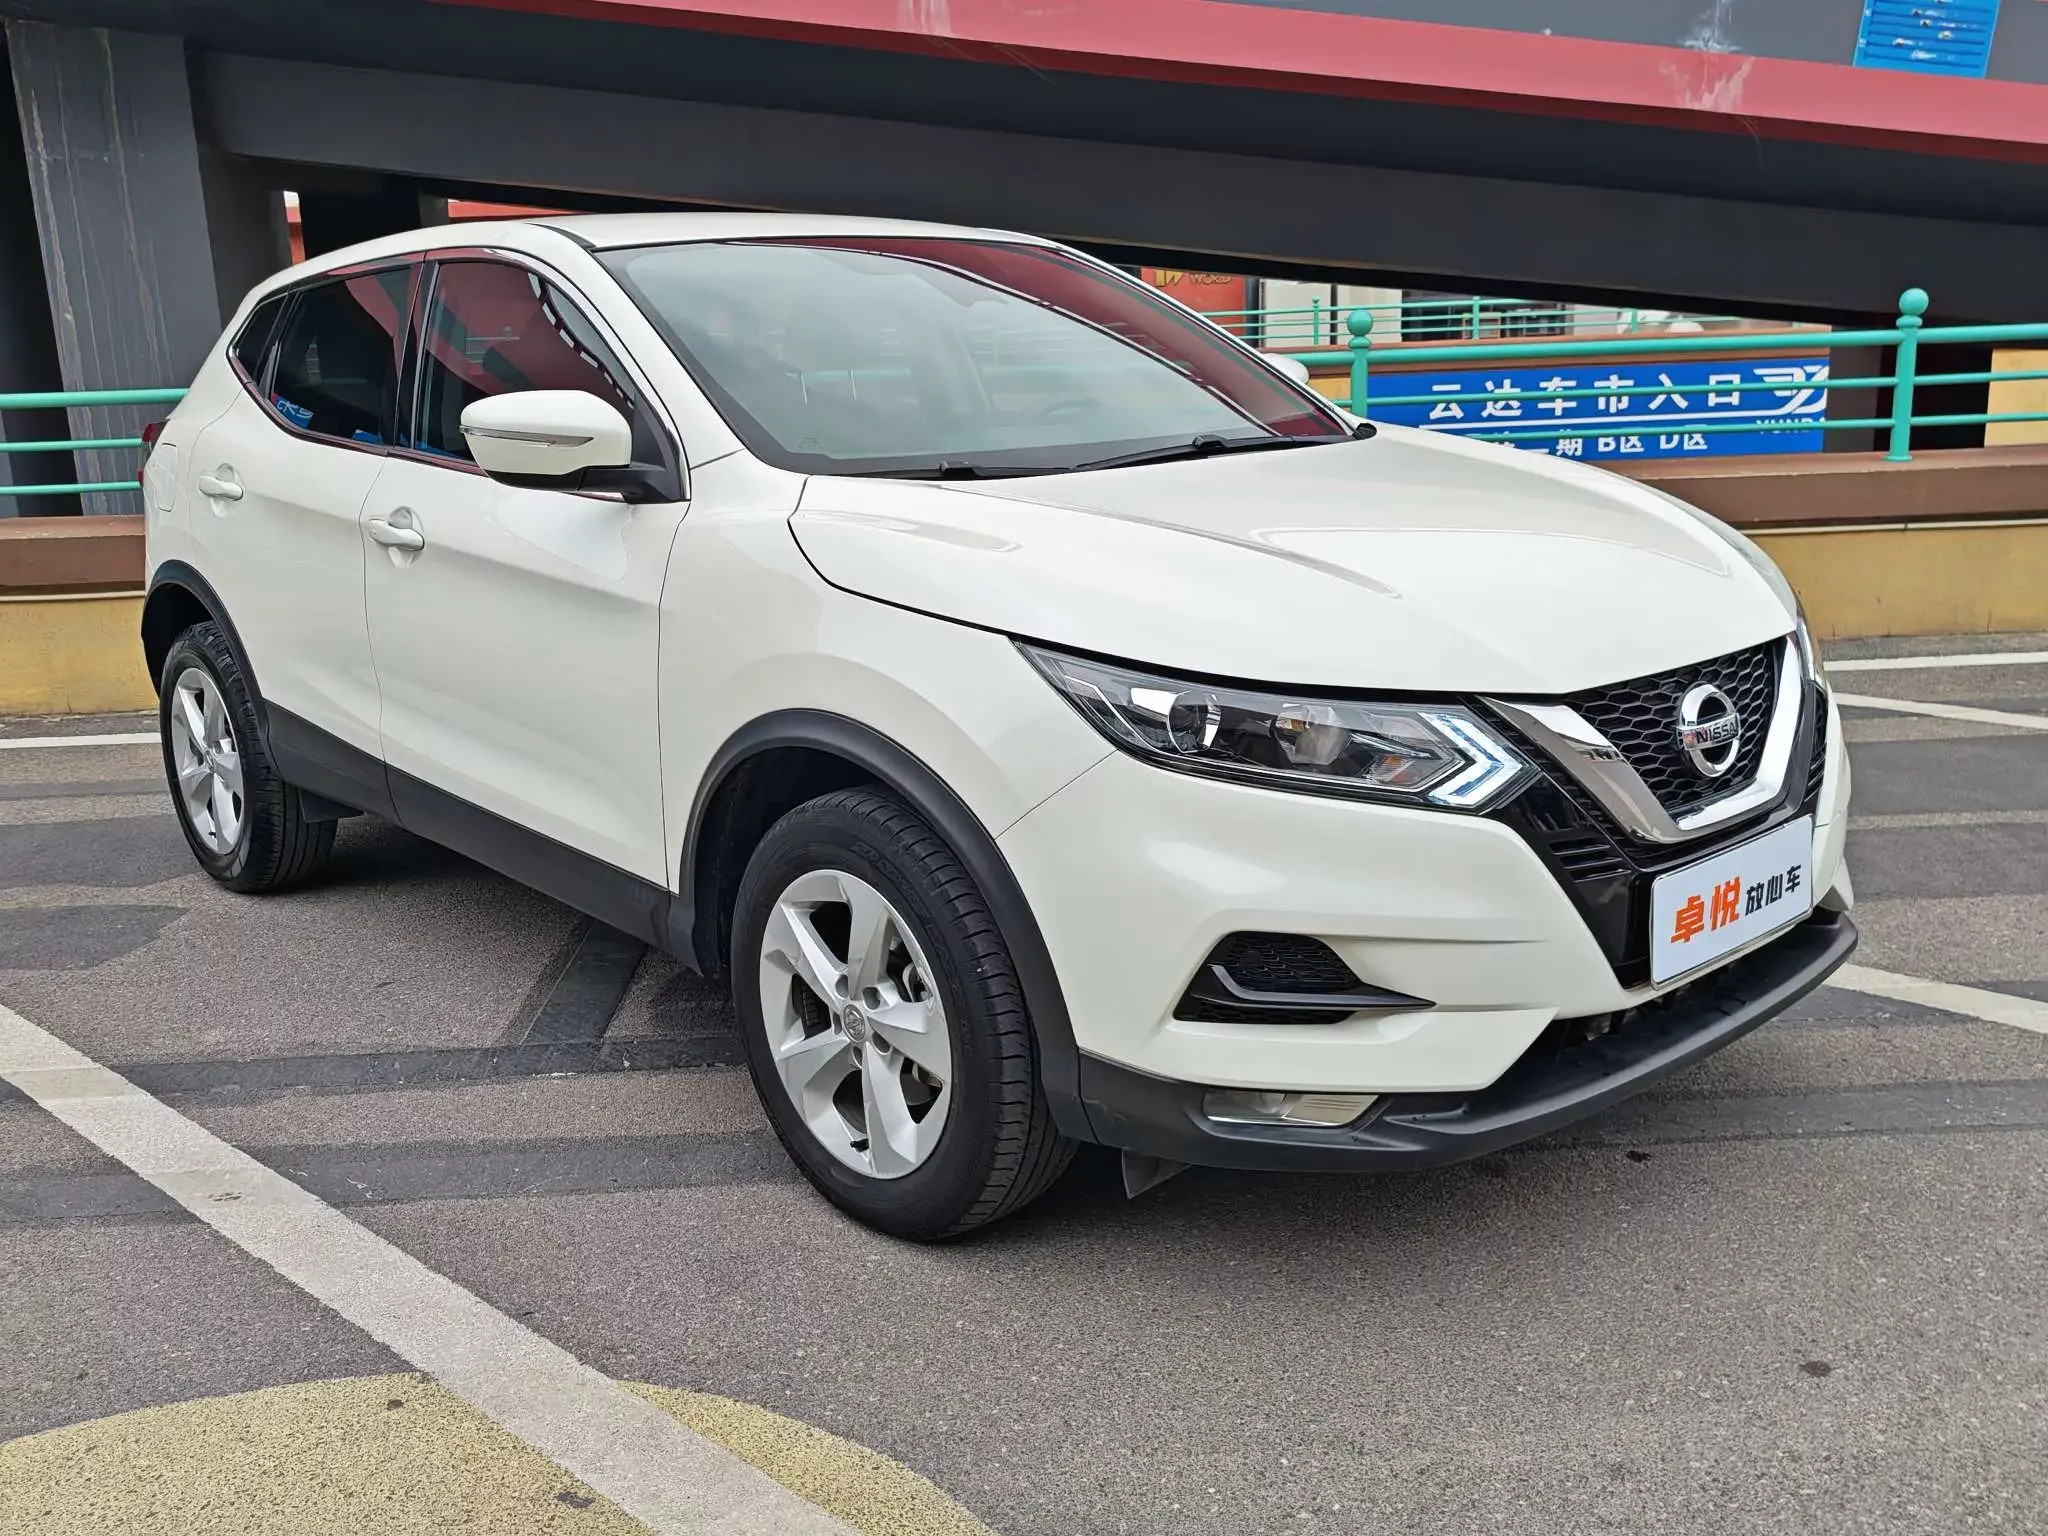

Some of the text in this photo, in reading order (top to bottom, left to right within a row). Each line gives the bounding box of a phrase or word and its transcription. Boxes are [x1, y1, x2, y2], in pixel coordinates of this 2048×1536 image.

[1428, 373, 1741, 420] 云达车市入口
[1670, 864, 1802, 944] 卓悦 放心车
